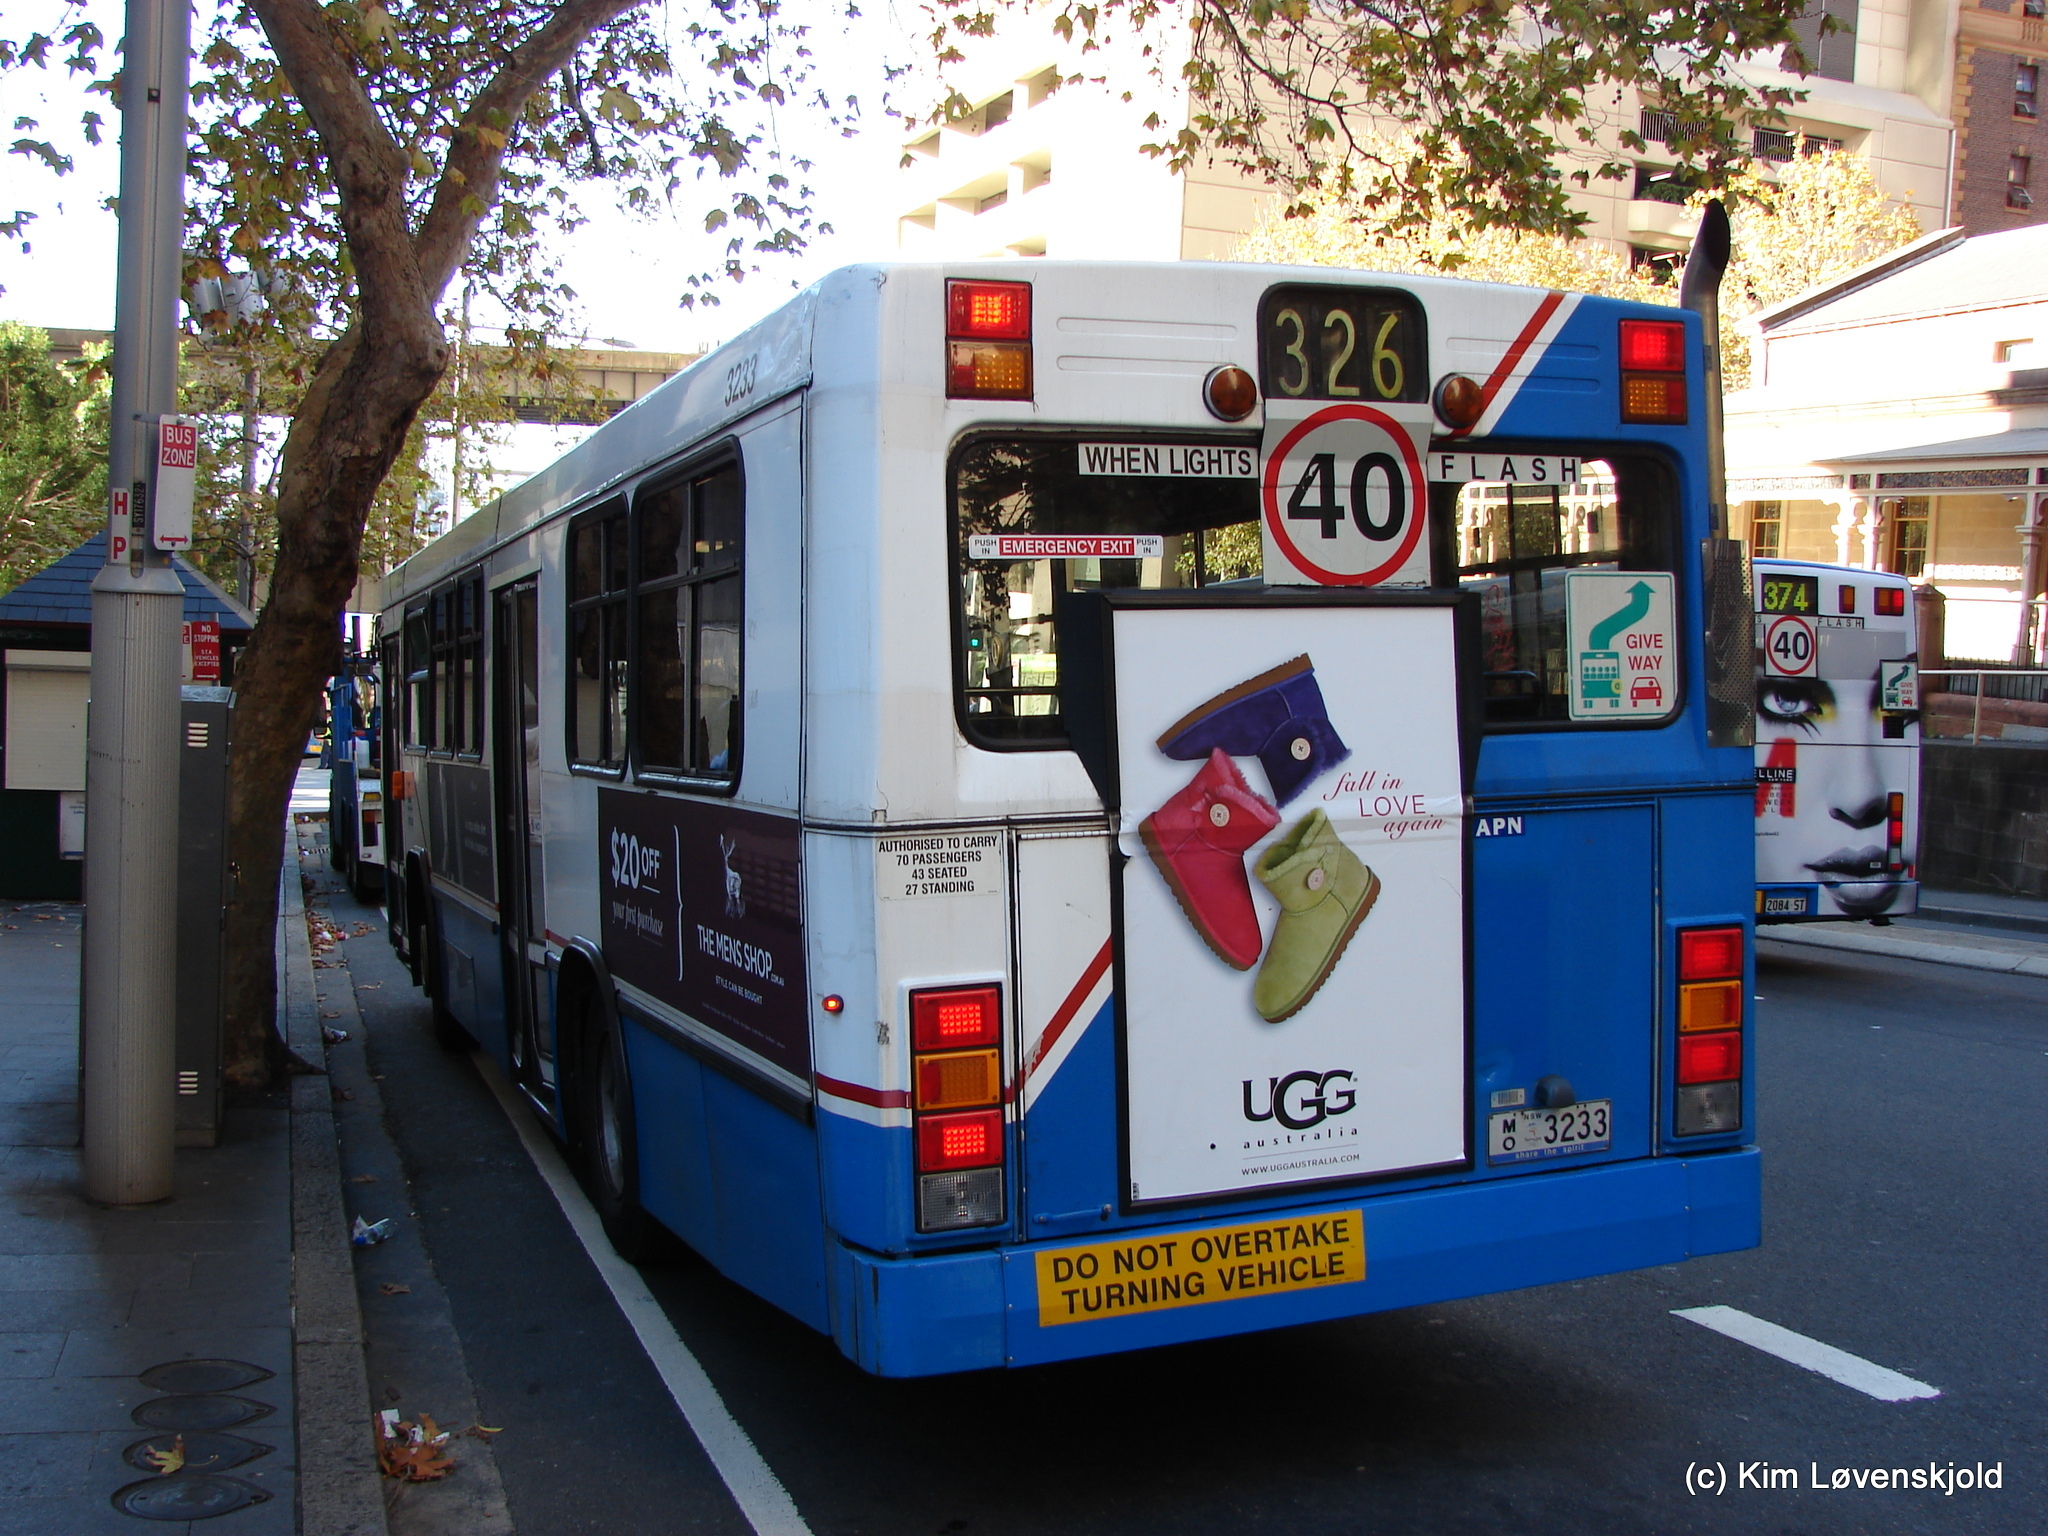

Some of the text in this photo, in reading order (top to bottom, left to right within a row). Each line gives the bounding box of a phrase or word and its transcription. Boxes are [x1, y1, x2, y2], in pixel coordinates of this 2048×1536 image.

[1275, 308, 1404, 399] 326
[724, 353, 758, 407] 3233
[166, 427, 192, 445] BUS
[162, 448, 194, 466] ZONE
[1085, 446, 1253, 476] WHEN LIGHTS
[1440, 456, 1579, 484] FLASH
[1287, 451, 1406, 542] 40
[974, 539, 997, 547] PUSH
[981, 547, 990, 555] IN
[1002, 540, 1133, 554] EMERGENCY EXIT
[1136, 538, 1158, 546] PUSH
[1764, 581, 1809, 611] 374
[201, 625, 212, 633] NO
[1817, 617, 1861, 628] FLASH
[194, 634, 219, 643] STOPPING
[1626, 634, 1664, 649] GIVE
[1773, 631, 1810, 660] 40
[1628, 655, 1663, 671] WAY
[1323, 771, 1403, 801] fall in
[1359, 794, 1426, 818] LOVE
[1383, 814, 1445, 840] again
[1476, 816, 1523, 837] APN
[878, 836, 998, 853] AUTHORISED TO CARRY
[611, 827, 660, 889] $20 OFF
[896, 851, 982, 866] 70 PASSENGERS
[912, 866, 967, 880] 43 SEATED
[905, 880, 975, 896] 27 STANDING
[1767, 899, 1805, 911] 2084 ST
[613, 899, 664, 937] your first purchase
[697, 924, 715, 956] THE
[715, 932, 742, 968] MENS
[715, 975, 763, 1005] STYLE CAN BE BOUGHT
[1242, 1069, 1357, 1130] UGG
[1523, 1112, 1543, 1120] NSW
[1543, 1108, 1607, 1144] 3233
[1243, 1127, 1358, 1149] australia
[1514, 1151, 1539, 1159] share
[1563, 1144, 1585, 1154] spirit
[1241, 1153, 1361, 1176] WWW.UGGAUSTRALIA.COM
[1052, 1218, 1350, 1283] DO NOT OVERTAKE
[1062, 1252, 1345, 1315] TURNING VEHICLE
